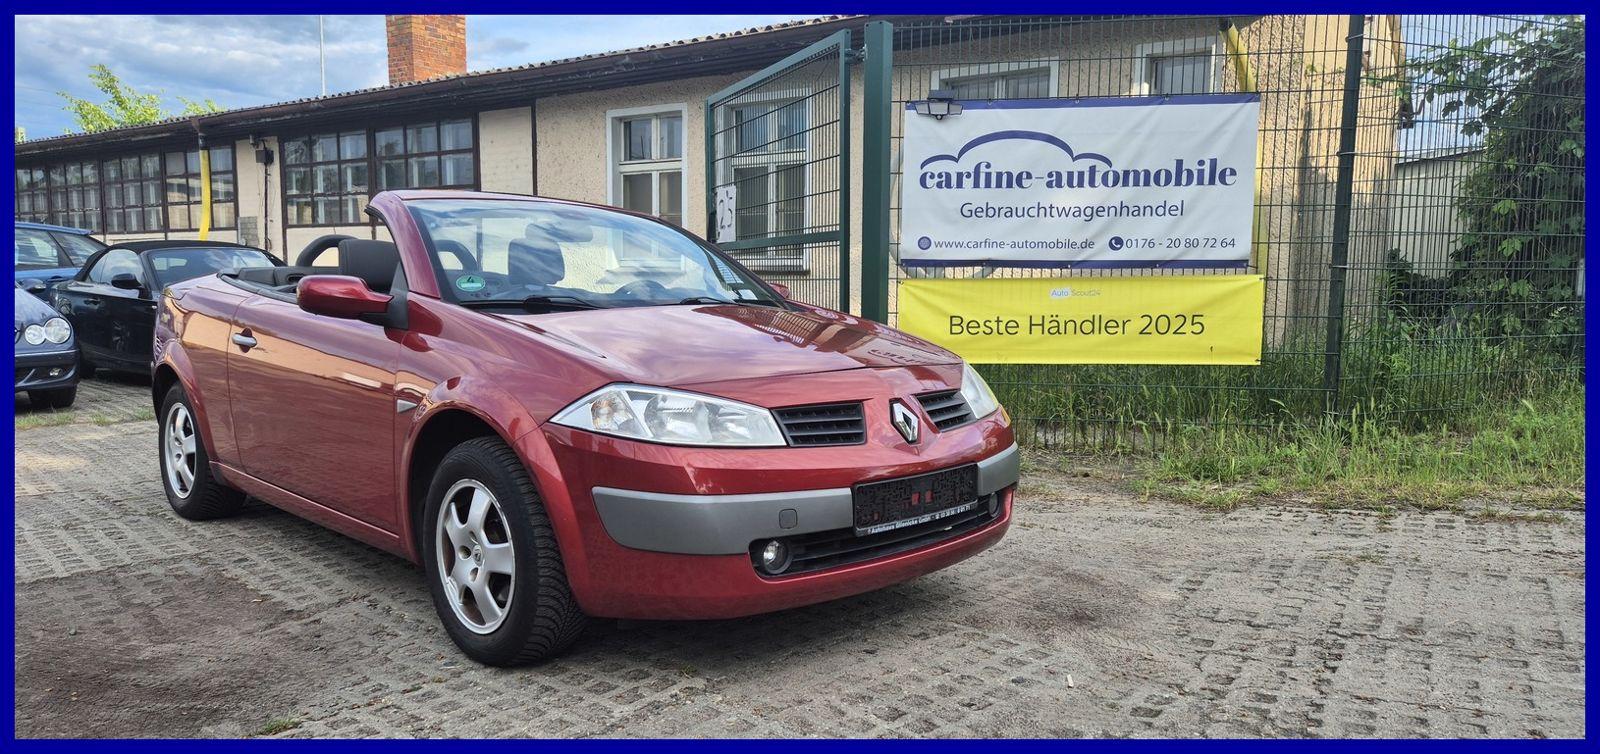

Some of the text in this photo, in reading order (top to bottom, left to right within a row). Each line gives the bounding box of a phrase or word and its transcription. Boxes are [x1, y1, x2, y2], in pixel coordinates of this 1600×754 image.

[919, 158, 1238, 190] carfine-automobile
[960, 200, 1184, 222] Gebrauchtwagenhandel
[934, 237, 1095, 250] www.carfine-automobile.de
[1125, 238, 1156, 249] 0176
[1166, 238, 1181, 249] 20
[1184, 238, 1199, 248] 80
[1203, 238, 1217, 248] 72
[1220, 238, 1236, 248] 64
[949, 314, 1205, 336] Beste Händler 2025
